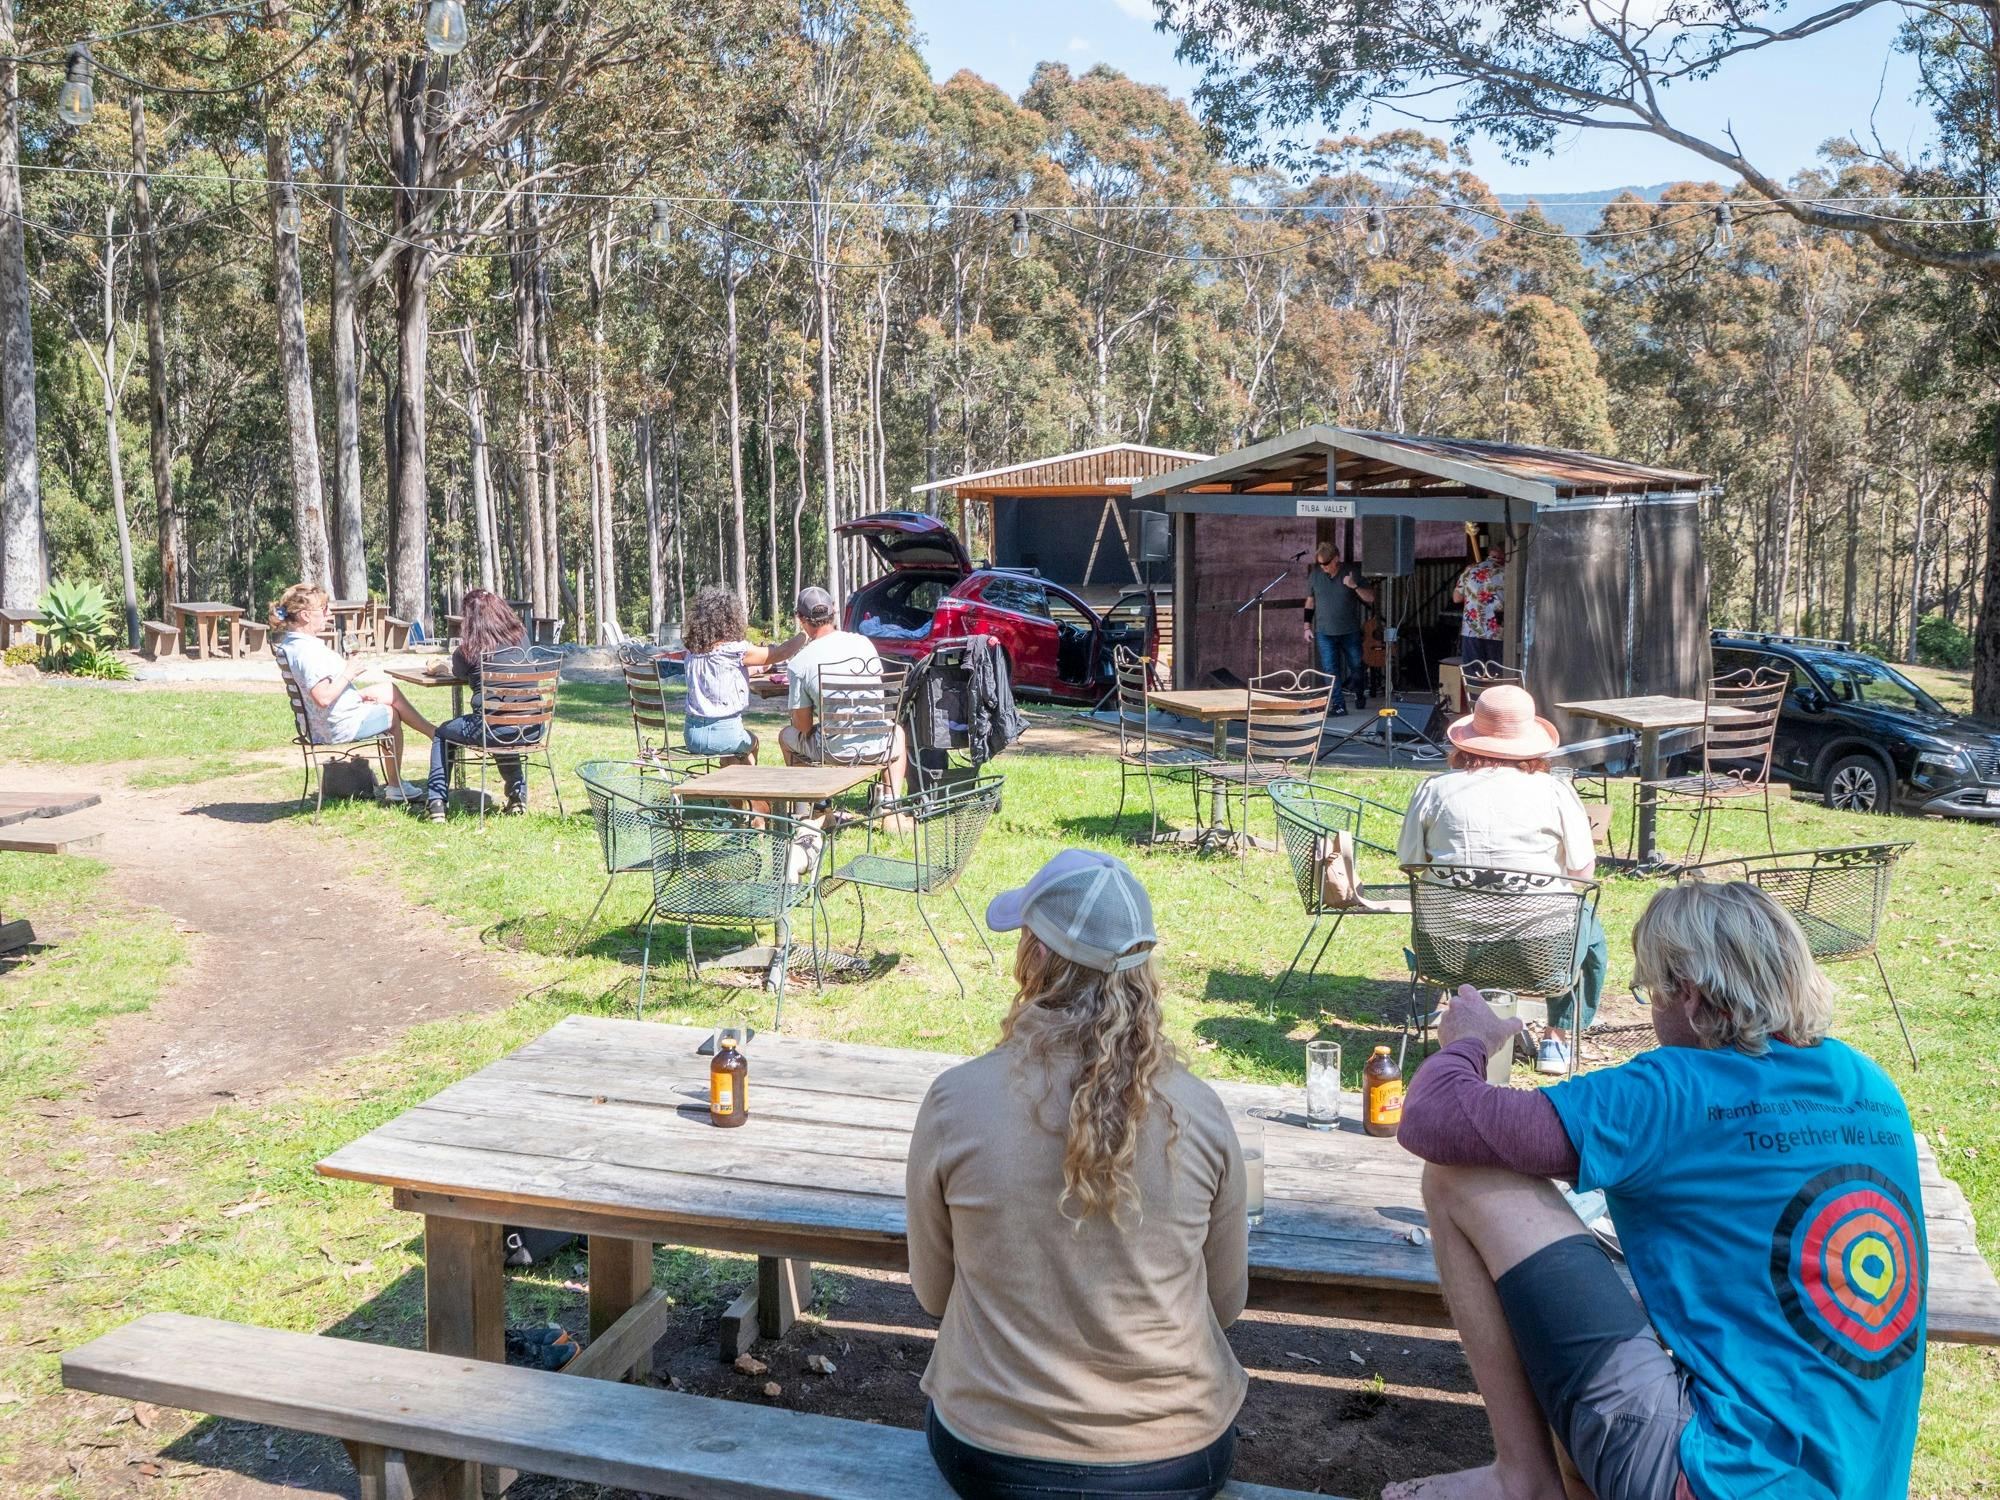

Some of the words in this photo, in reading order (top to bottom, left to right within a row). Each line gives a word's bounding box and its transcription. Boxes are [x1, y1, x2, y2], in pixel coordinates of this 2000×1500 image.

[1301, 504, 1320, 512] TILBA
[1323, 504, 1347, 513] VALLEY
[1743, 1124, 1838, 1153] Together
[1841, 1125, 1865, 1146] We
